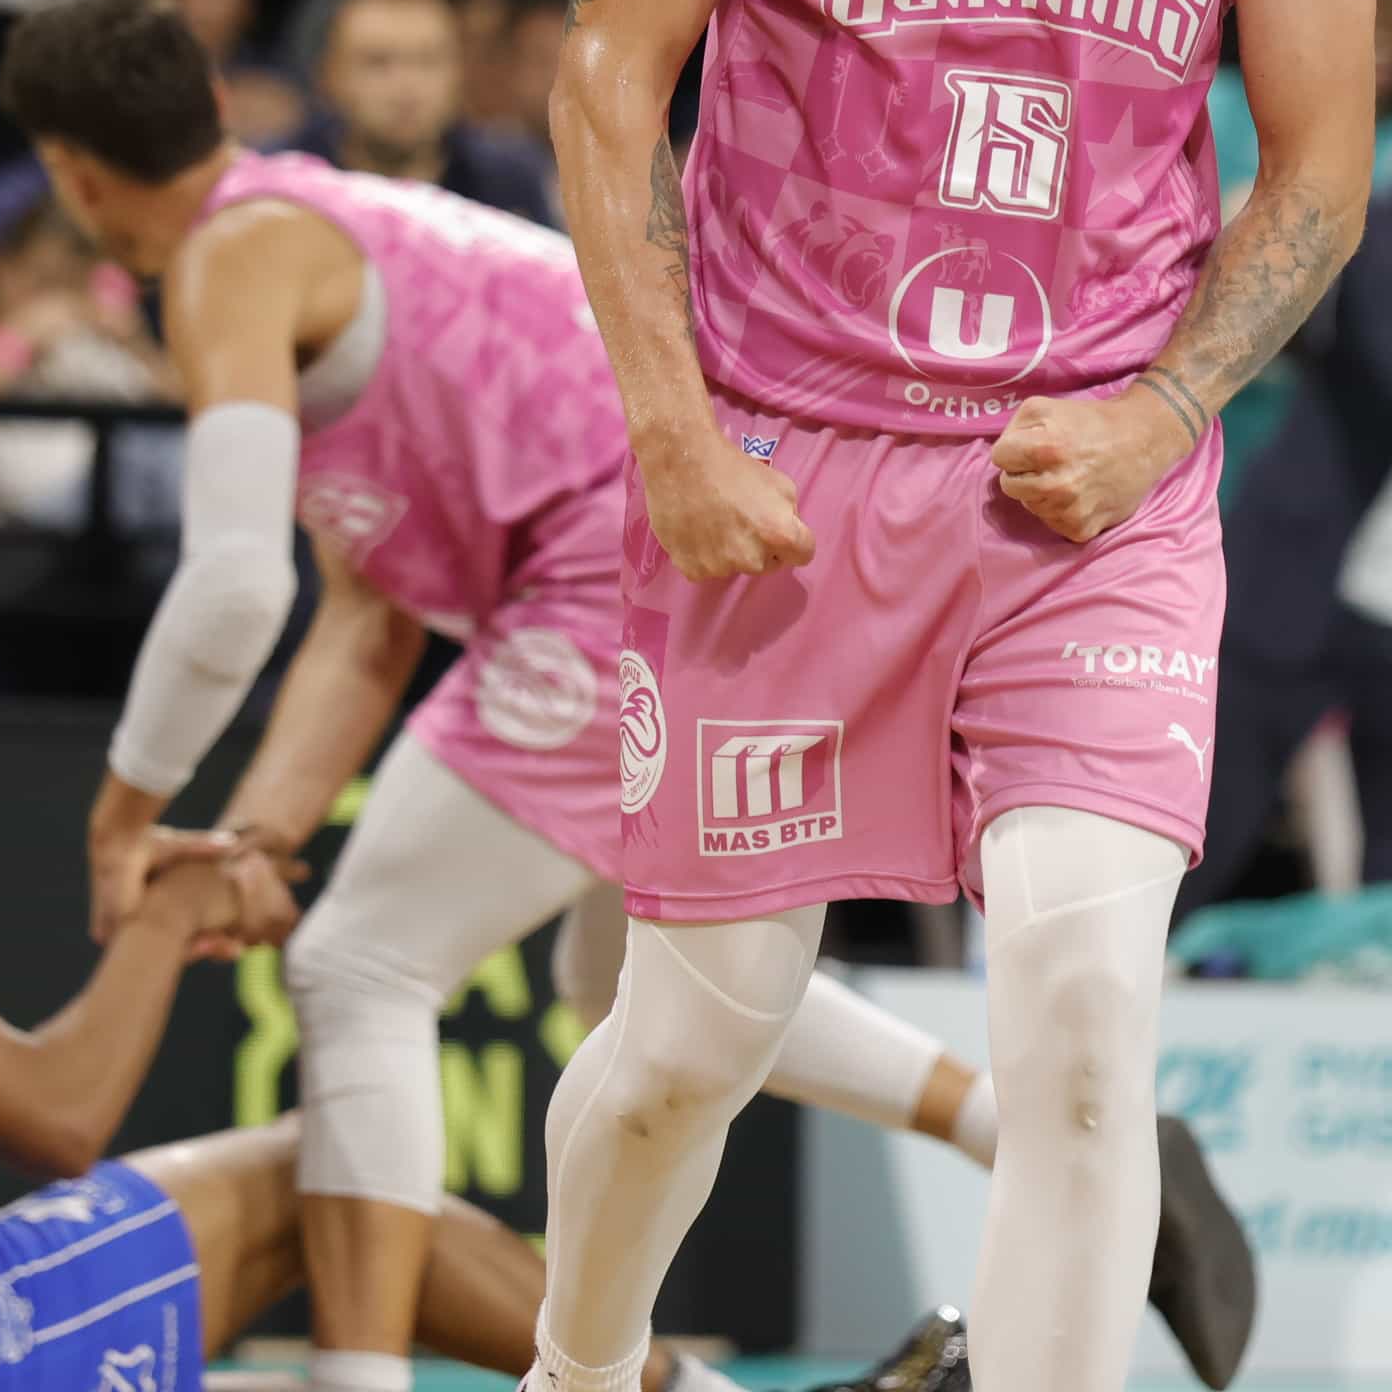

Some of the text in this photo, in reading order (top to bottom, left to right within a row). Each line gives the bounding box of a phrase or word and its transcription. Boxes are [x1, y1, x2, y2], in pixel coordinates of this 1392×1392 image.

[946, 76, 1068, 214] 15
[929, 287, 1015, 359] U
[904, 382, 1024, 420] Orthez
[703, 815, 837, 852] MAS BTP
